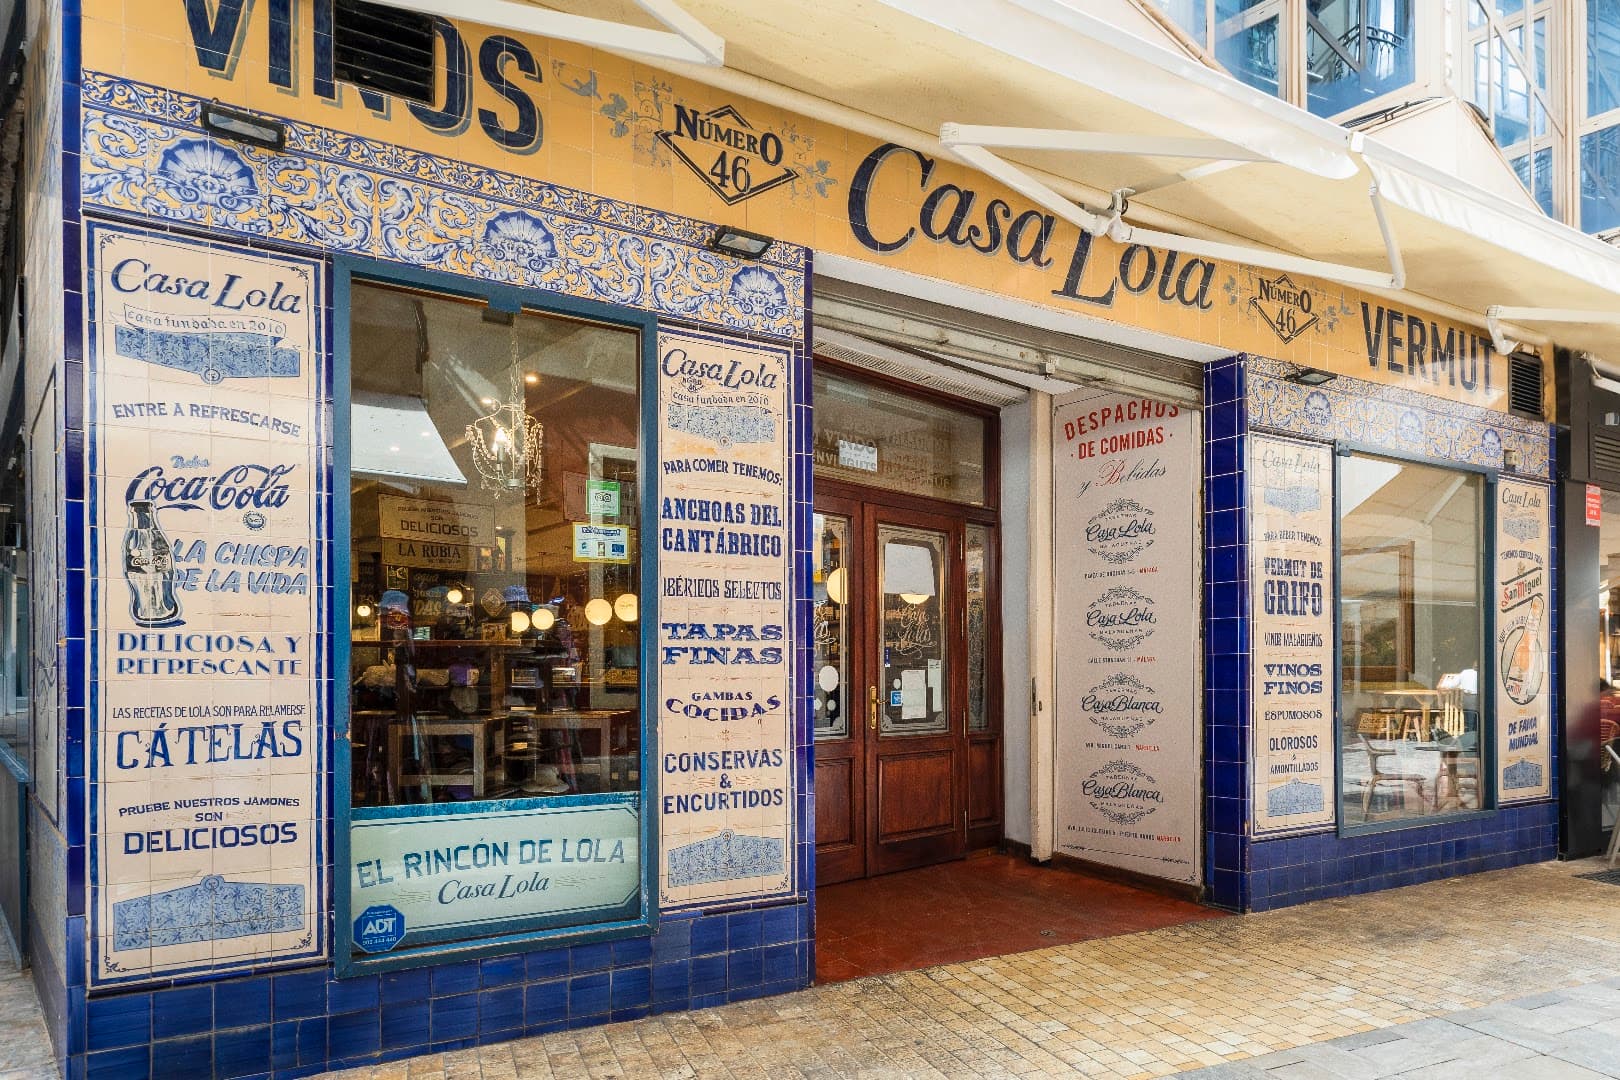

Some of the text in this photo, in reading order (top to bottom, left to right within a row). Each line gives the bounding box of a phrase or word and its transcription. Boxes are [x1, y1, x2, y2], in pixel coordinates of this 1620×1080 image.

[673, 104, 783, 166] NÚMERO
[711, 150, 752, 194] 46
[848, 143, 1216, 311] Casa Lola
[111, 258, 301, 313] Casa Lola
[1258, 279, 1313, 314] NÚMERO
[1275, 308, 1296, 334] 46
[1361, 300, 1496, 396] VERMUT
[661, 348, 723, 382] Casa
[722, 359, 777, 390] Lola
[112, 402, 301, 438] ENTRE A REFRESCARSE
[1064, 399, 1180, 441] DESPACHOS
[1078, 426, 1165, 460] DE COMIDAS
[663, 458, 783, 486] PARA COMER TENEMOS:
[1076, 458, 1167, 499] y Bebidas
[1502, 487, 1541, 508] Casa Lola
[662, 497, 745, 524] ANCHOAS
[750, 504, 782, 527] DEL
[400, 520, 479, 537] DELICIOSOS
[1086, 518, 1156, 542] Casa Lola
[174, 538, 310, 568] LA CHISPA
[398, 543, 461, 558] LA RUBIA
[662, 527, 782, 558] CANTÁBRICO
[1264, 556, 1323, 579] VERMUT DE
[205, 568, 241, 594] LA
[247, 571, 310, 595] VIDA
[663, 575, 782, 600] IBÉRICOS SELECTOS
[1516, 573, 1543, 600] Miguel
[1264, 579, 1323, 617] GRIFO
[1086, 607, 1157, 628] Casa Lola
[117, 631, 302, 654] DELICIOSA Y
[661, 622, 783, 642] TAPAS
[116, 657, 303, 676] REFRESCANTE
[662, 646, 783, 665] FINAS
[1263, 663, 1323, 678] VINOS
[691, 692, 753, 702] GAMBAS
[1263, 680, 1323, 696] FINOS
[113, 704, 306, 719] LAS RECETAS DE LOLA SON PARA RELAMERSE
[665, 695, 781, 722] COCIDAS
[1264, 709, 1323, 721] ESPUMOSOS
[1508, 720, 1518, 736] DE
[116, 720, 303, 770] CÁTELAS
[1269, 735, 1318, 751] OLOROSOS
[1508, 731, 1539, 753] MUNDIAL
[664, 748, 784, 774] CONSERVAS
[1270, 761, 1319, 775] AMONTILLADOS
[719, 773, 732, 789] &
[118, 797, 300, 817] PRUEBE NUESTROS JAMONES
[664, 788, 784, 815] ENCURTIDOS
[195, 811, 223, 822] SON
[123, 822, 297, 855] DELICIOSOS
[356, 837, 625, 888] EL RINCÓN DE LOLA
[438, 871, 550, 905] Casa Lola
[362, 917, 396, 935] ADT
